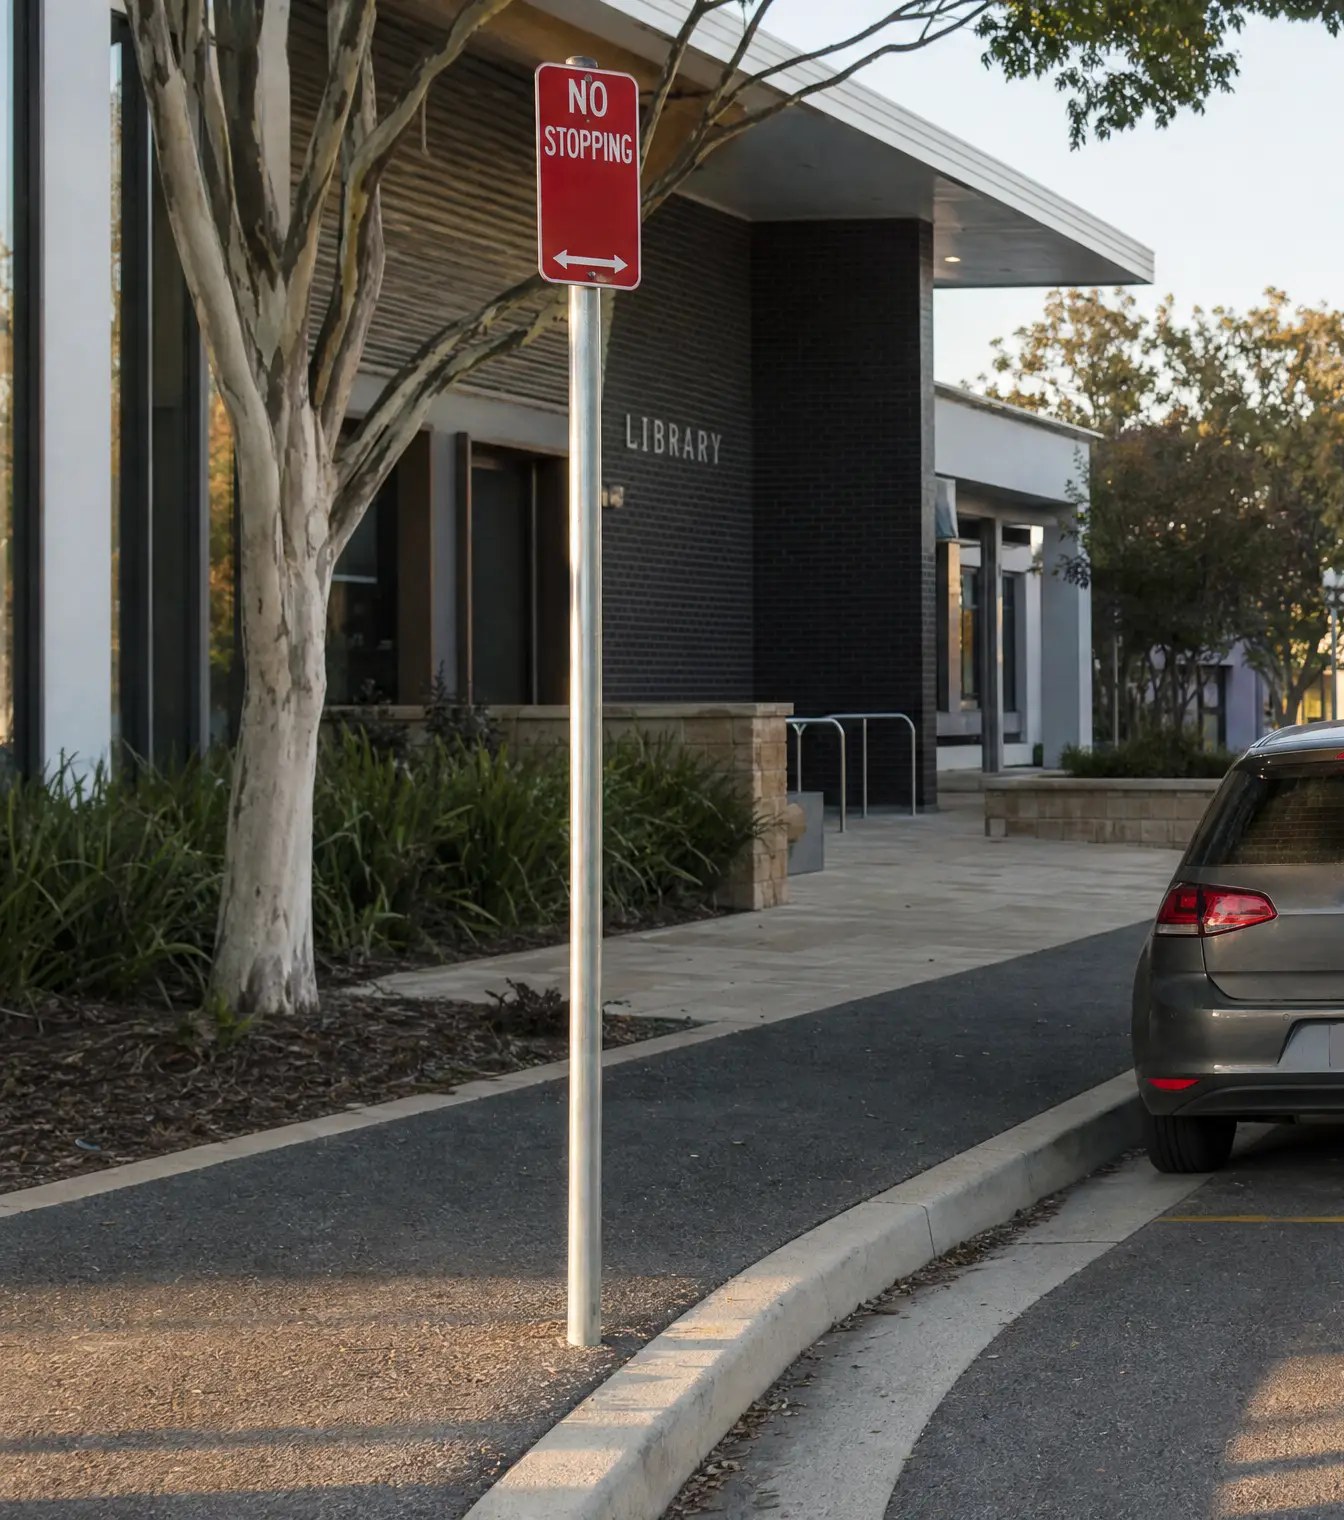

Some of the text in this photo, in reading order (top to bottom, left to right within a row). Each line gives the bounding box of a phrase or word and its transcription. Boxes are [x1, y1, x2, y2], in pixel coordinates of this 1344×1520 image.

[568, 78, 608, 117] NO
[544, 125, 633, 164] STOPPING
[625, 413, 721, 464] LIBRARY
